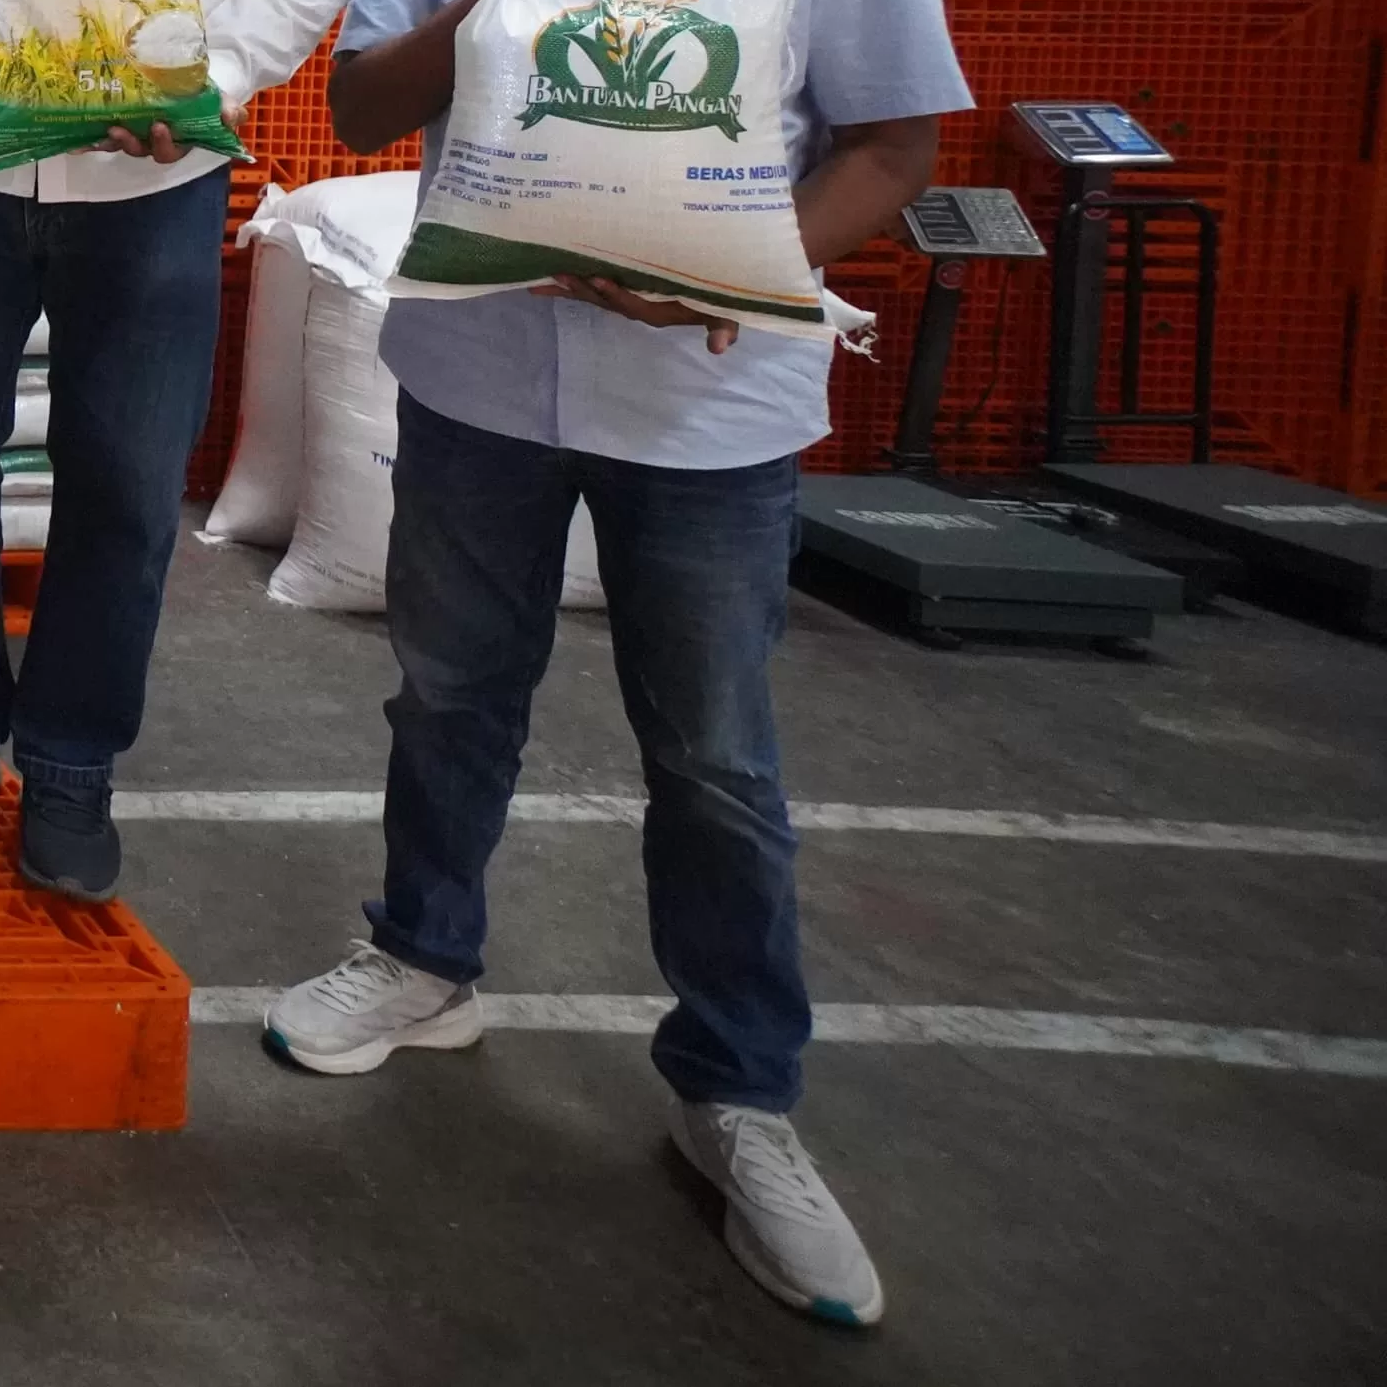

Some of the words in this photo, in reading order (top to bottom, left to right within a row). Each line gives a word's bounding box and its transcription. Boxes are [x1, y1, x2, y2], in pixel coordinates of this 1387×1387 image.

[78, 69, 95, 93] 5
[99, 75, 123, 93] kg
[527, 75, 639, 109] BANTUAN
[644, 79, 742, 115] PANGAN
[686, 166, 744, 181] BERAS
[749, 165, 788, 180] MEDIU
